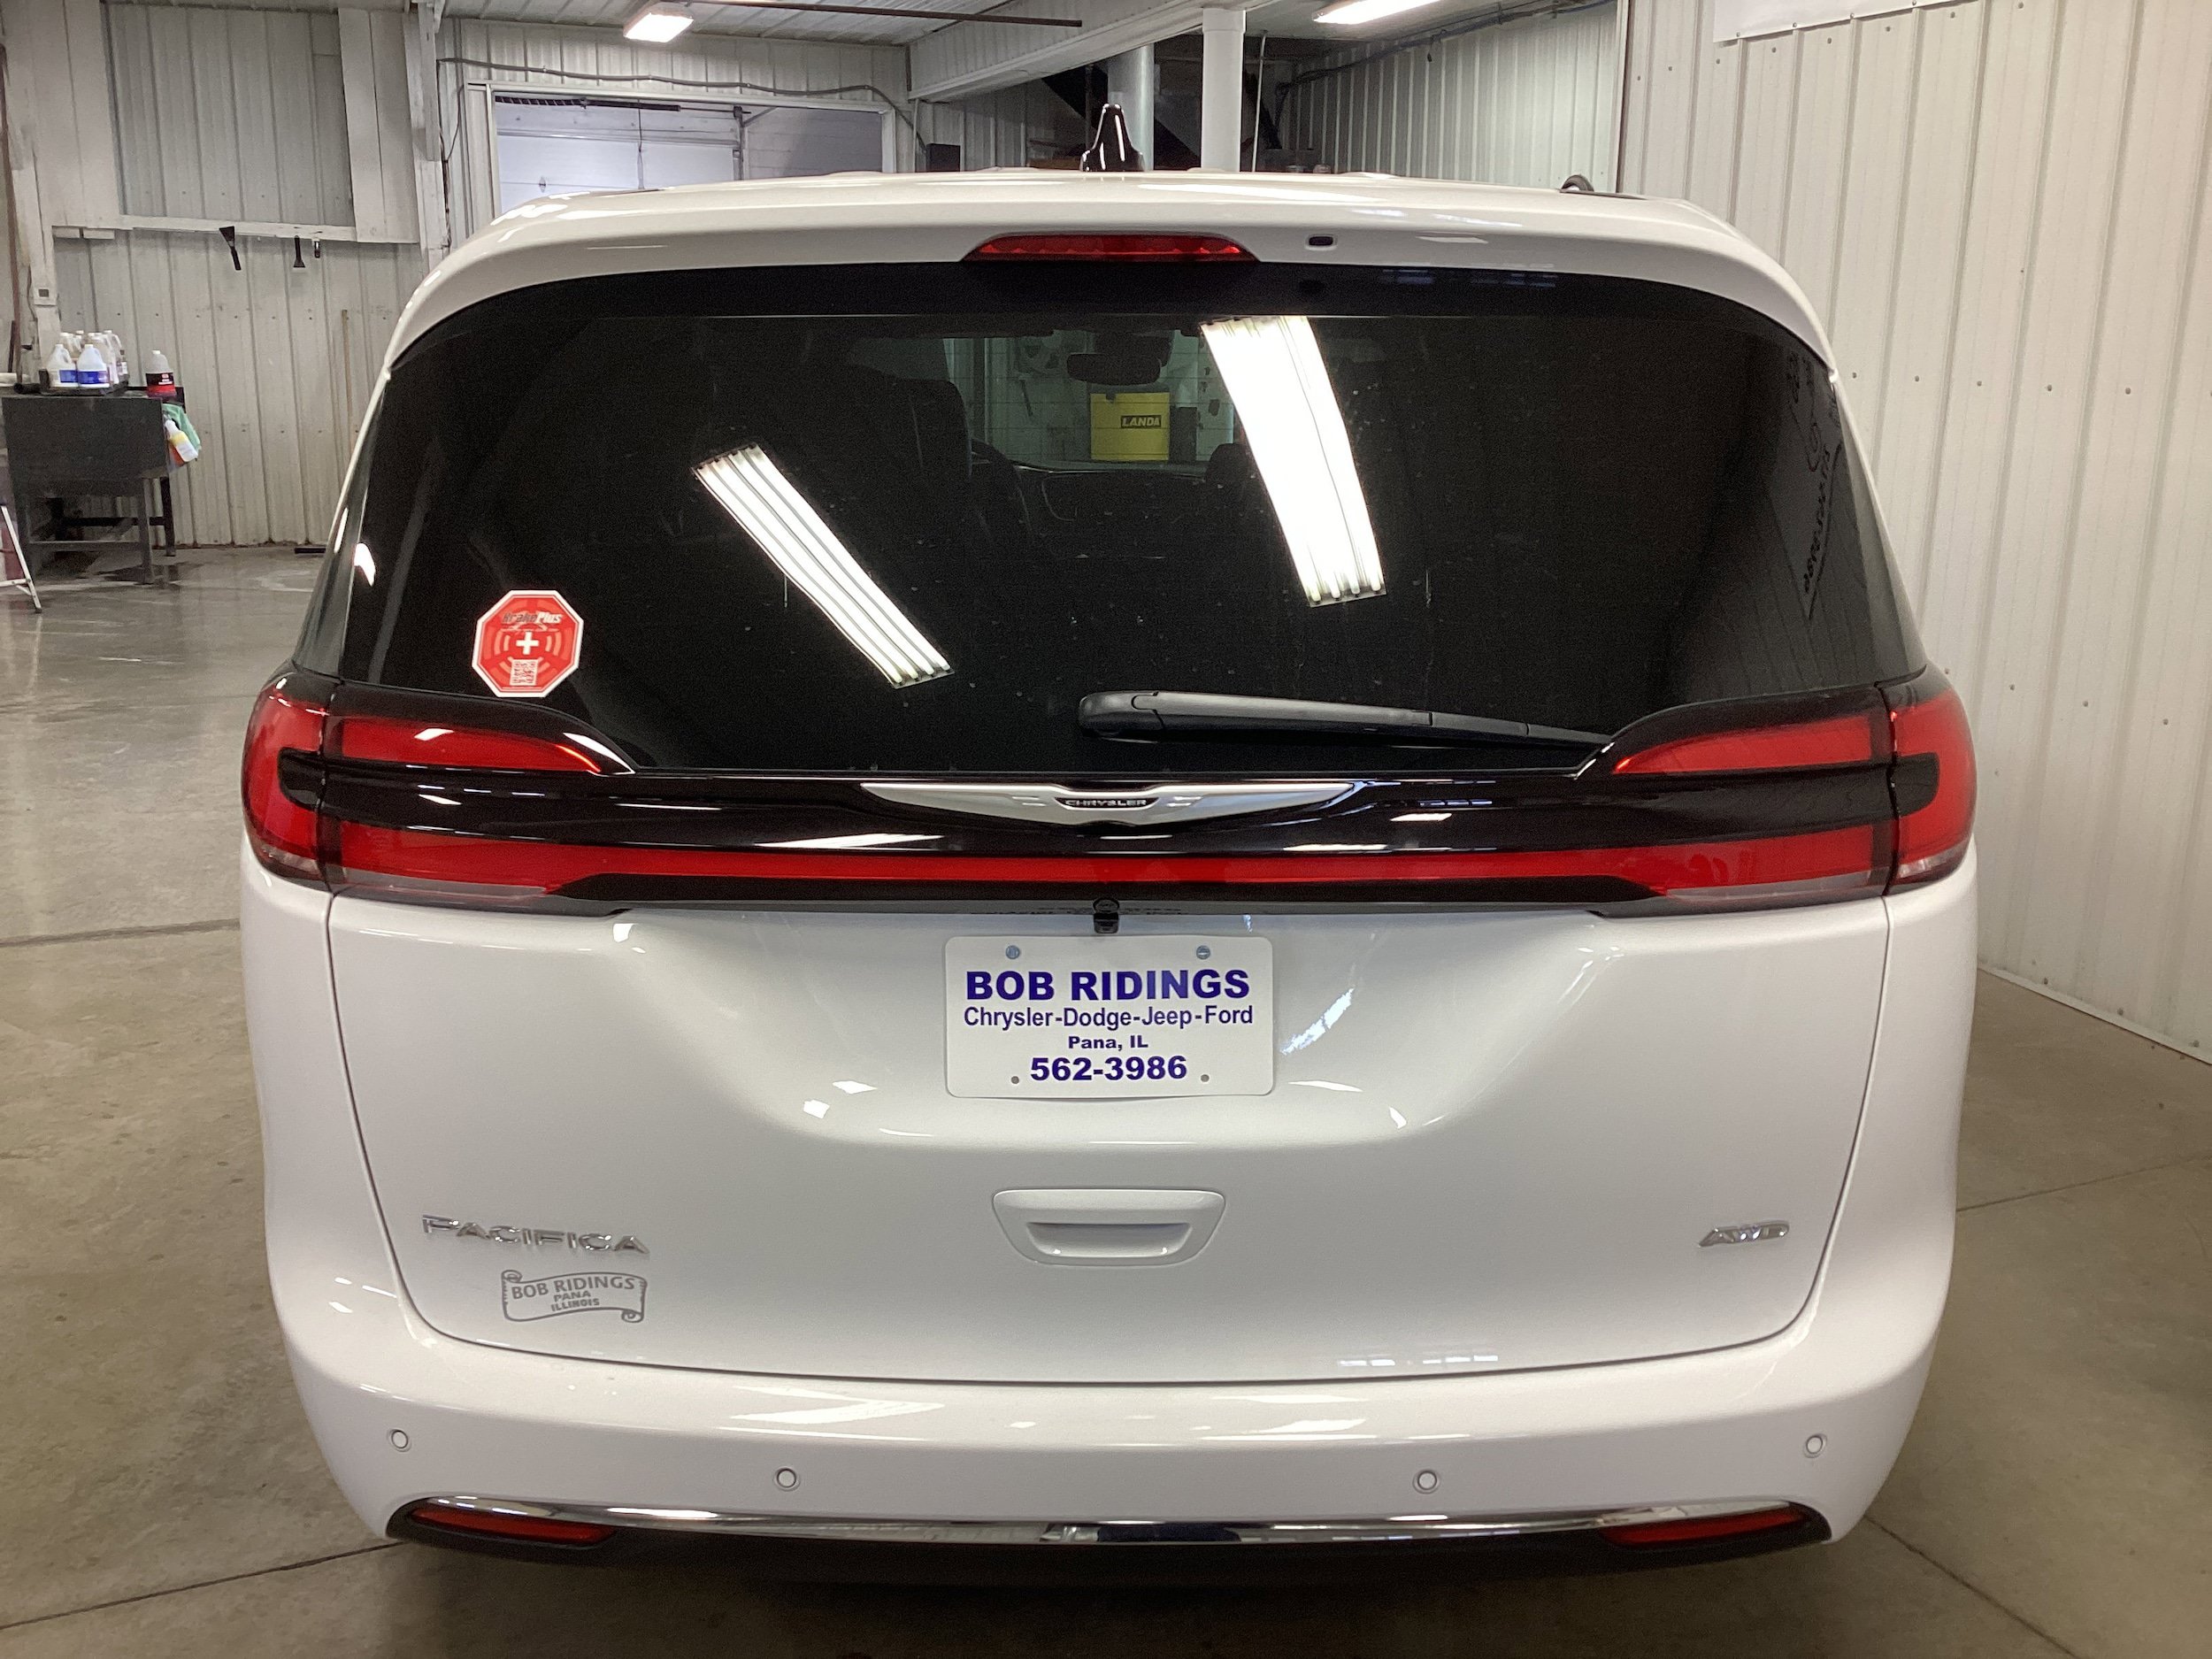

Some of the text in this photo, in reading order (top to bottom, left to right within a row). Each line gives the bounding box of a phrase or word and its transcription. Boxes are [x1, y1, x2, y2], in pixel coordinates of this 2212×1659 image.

[1122, 416, 1160, 426] LANDA
[966, 969, 1250, 1001] BOB RIDINGS
[964, 1005, 1253, 1031] Chrysler-Dodge-Jeep-Ford
[1068, 1035, 1148, 1051] Pana, IL
[1030, 1056, 1187, 1081] 562-3986
[422, 1214, 650, 1255] PACIFICA
[1699, 1220, 1789, 1247] AWD
[511, 1276, 635, 1300] BOB RIDINGS
[554, 1290, 591, 1302] PANA
[551, 1298, 600, 1312] ILLINOIS
